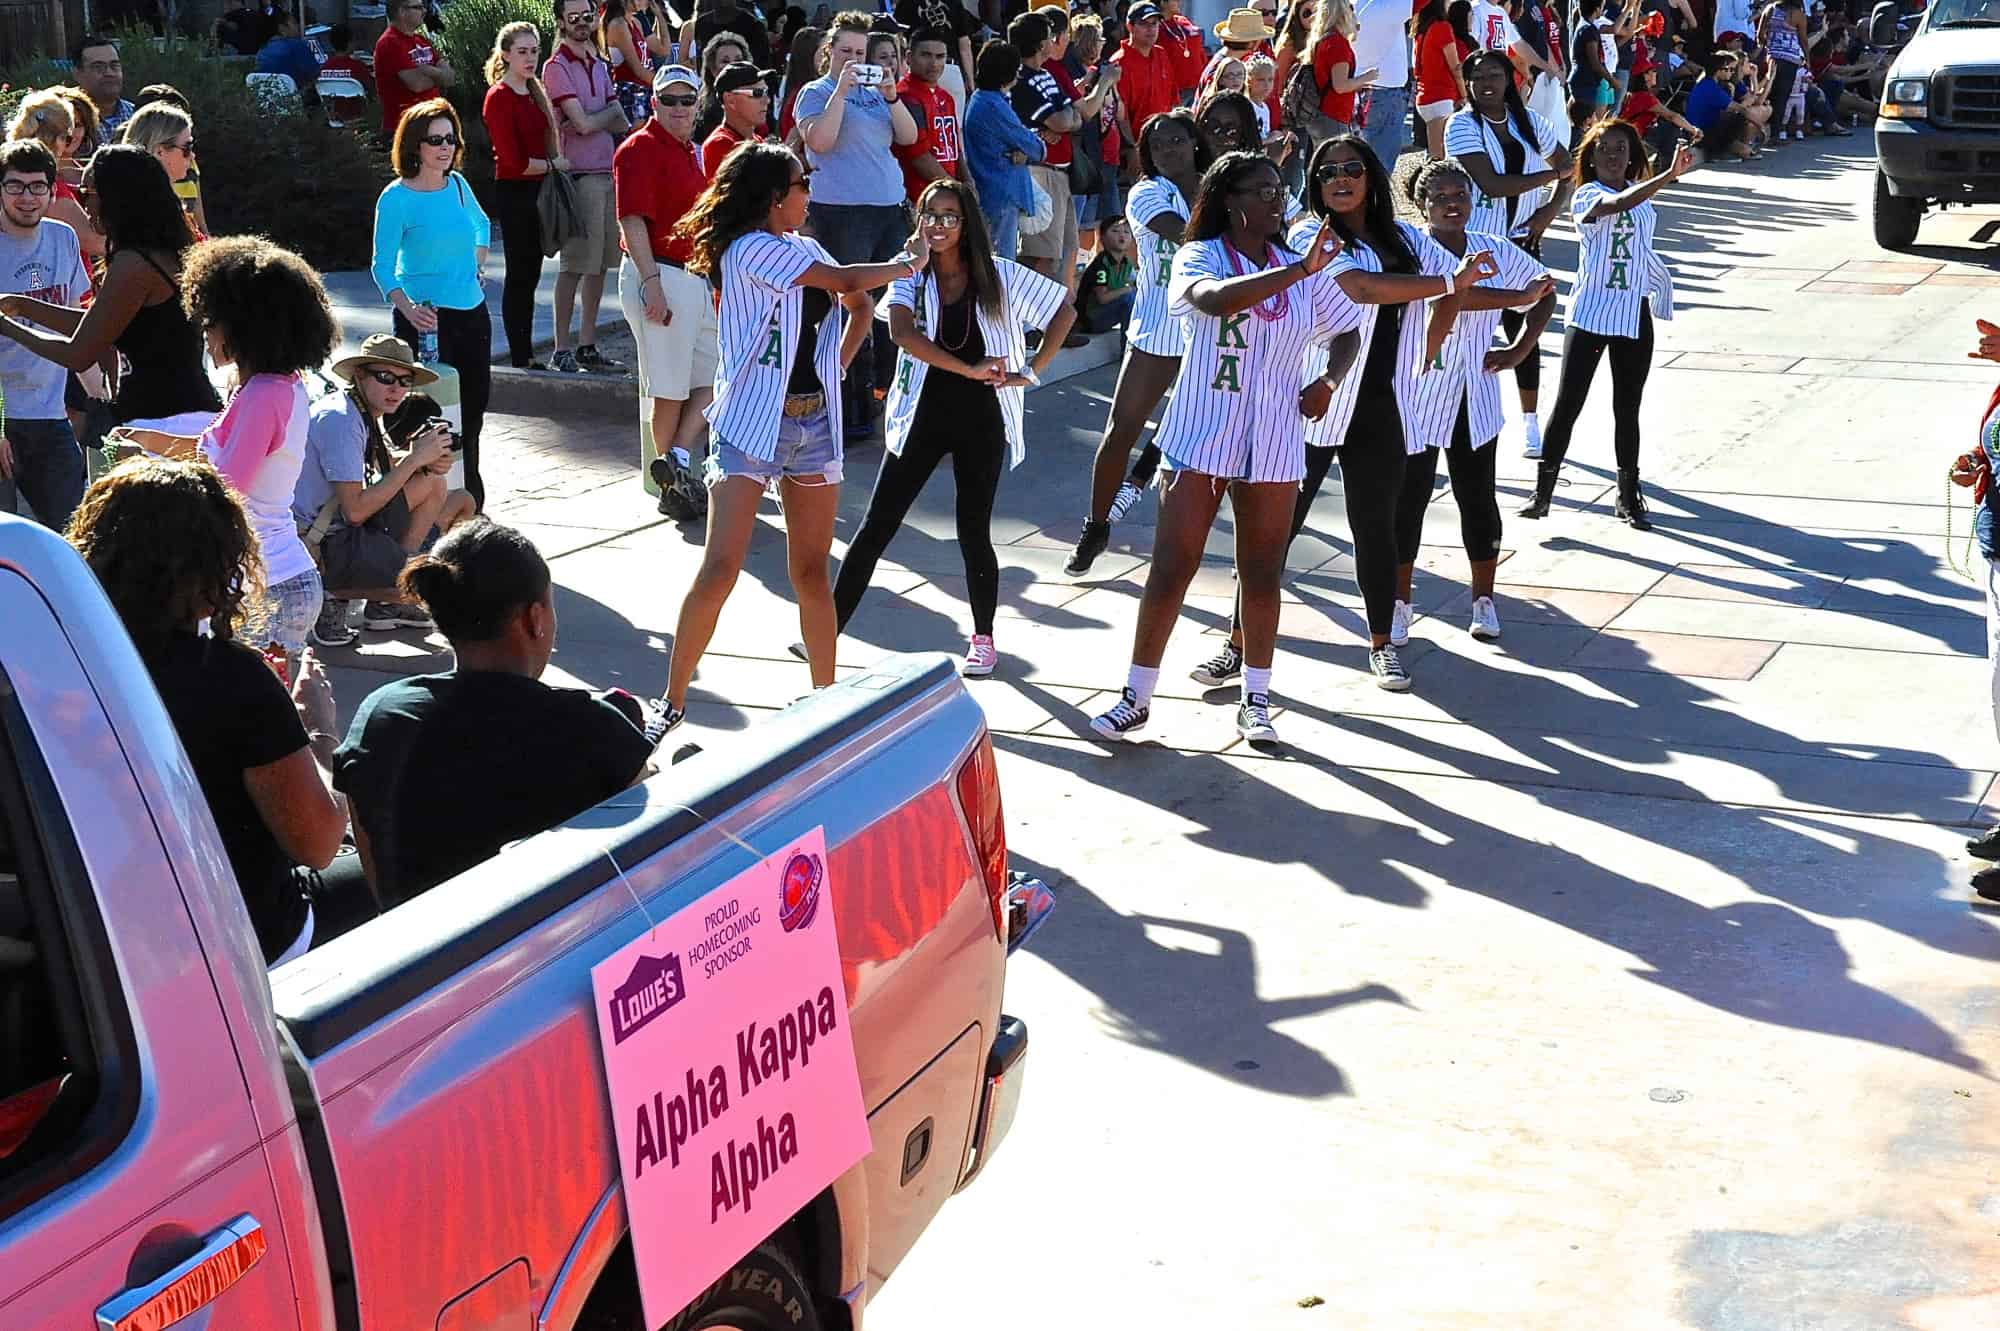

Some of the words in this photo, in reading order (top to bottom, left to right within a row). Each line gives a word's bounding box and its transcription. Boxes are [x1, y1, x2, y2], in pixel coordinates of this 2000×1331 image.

[1096, 271, 1107, 284] 3
[1605, 210, 1636, 291] AKA
[688, 907, 761, 967] HOMECOMING
[705, 899, 739, 932] PROUD
[704, 936, 752, 979] SPONSOR
[617, 969, 678, 1032] LOWE'S
[635, 1064, 729, 1179] Alpha
[736, 985, 837, 1097] Kappa
[710, 1112, 799, 1224] Alpha
